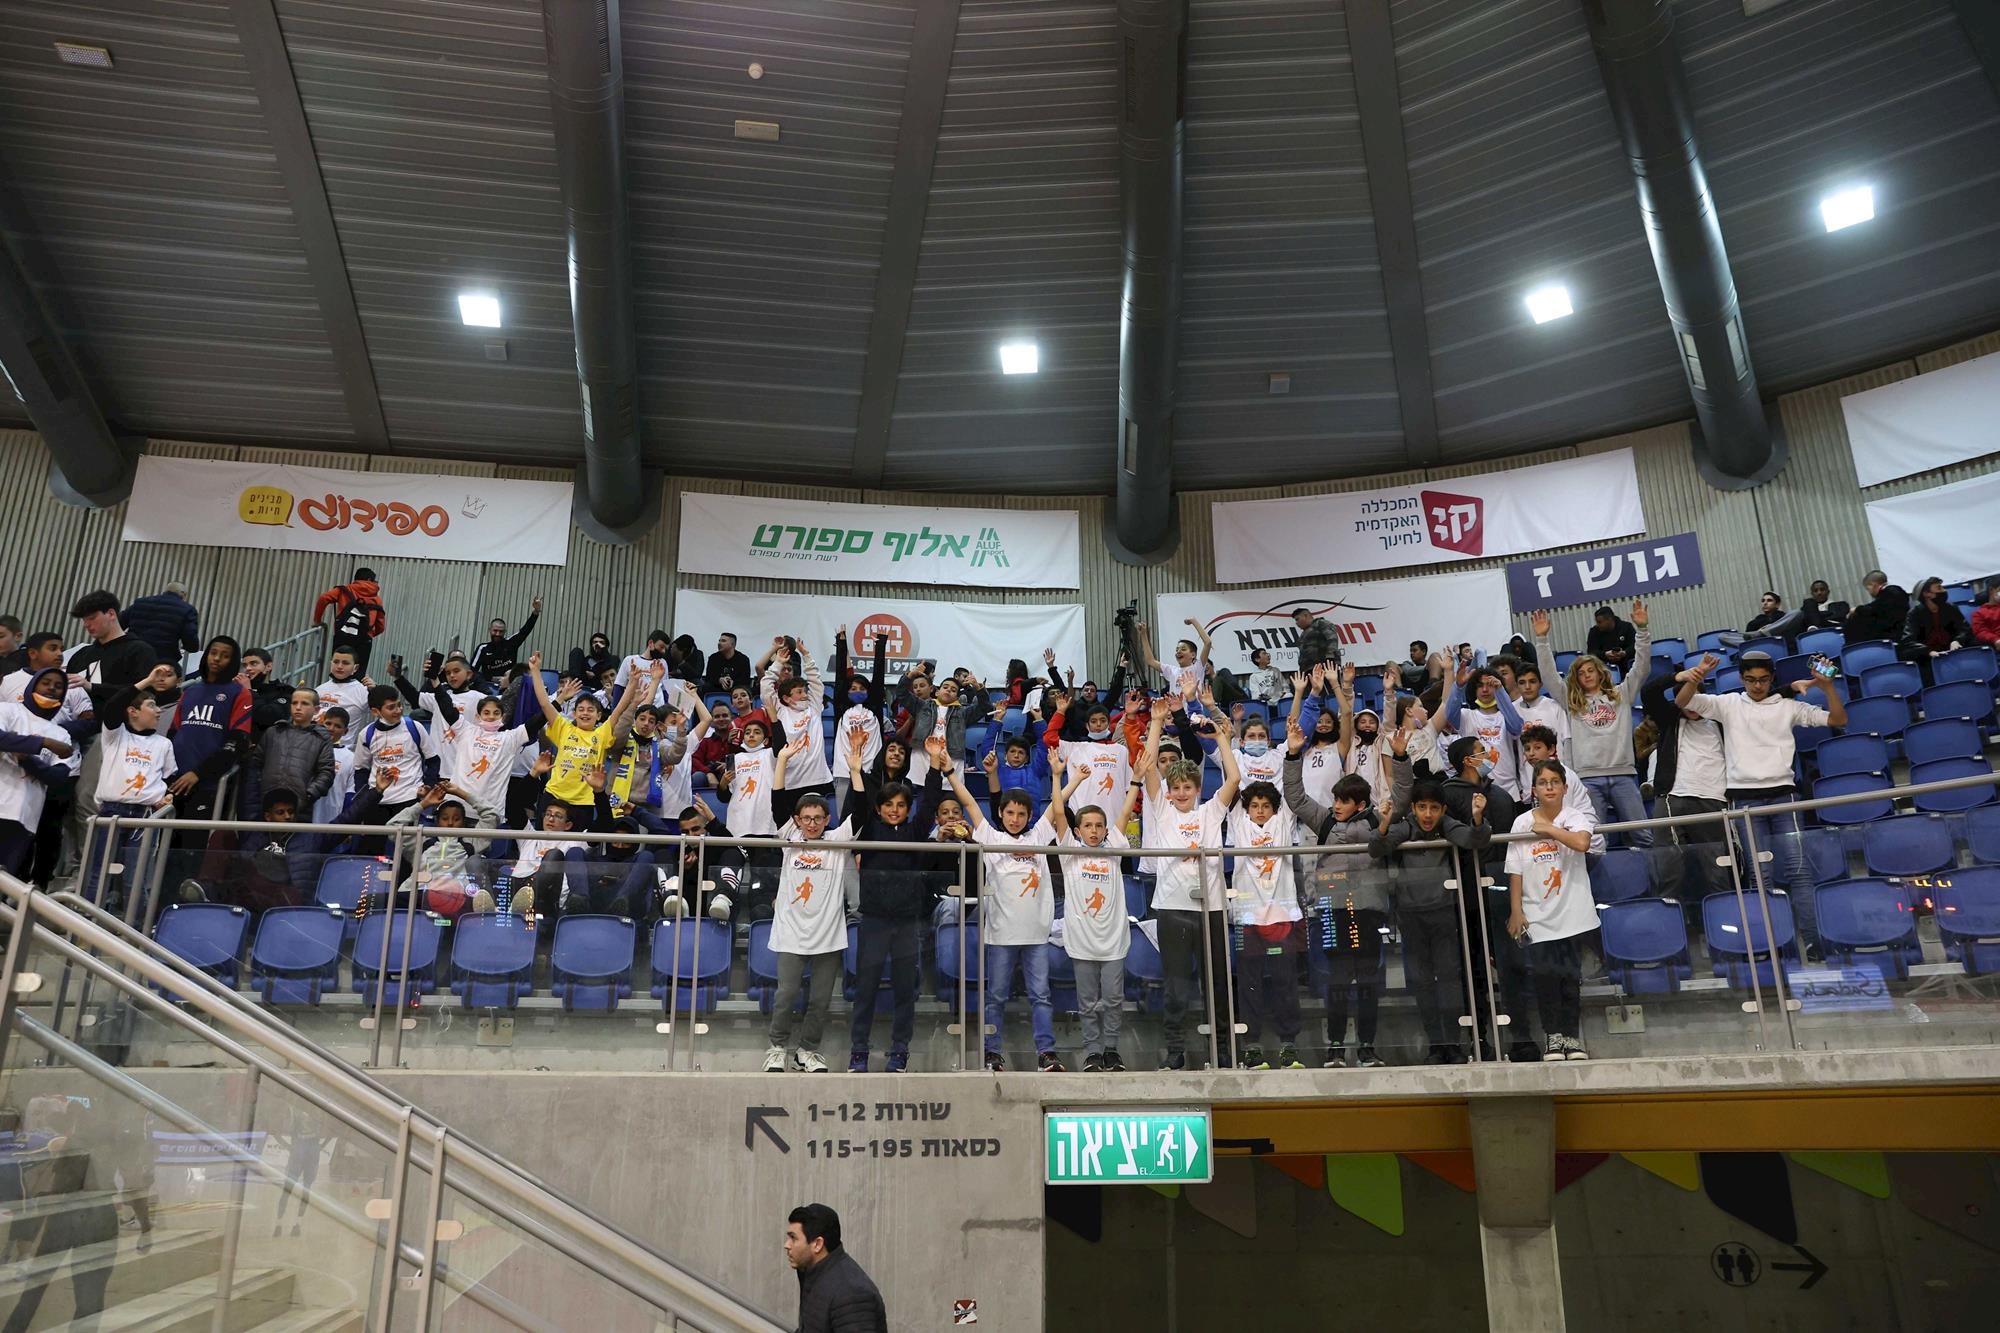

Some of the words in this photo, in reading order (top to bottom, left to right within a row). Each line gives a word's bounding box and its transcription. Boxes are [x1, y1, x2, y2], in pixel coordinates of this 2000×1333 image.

[250, 494, 282, 504] מבינים
[1361, 497, 1418, 515] המכללה
[1355, 514, 1420, 533] האקדמית
[751, 524, 874, 554] ספורט
[882, 526, 971, 562] אלוף
[976, 541, 1001, 549] ALUF
[1379, 530, 1422, 550] לחינוך
[749, 549, 780, 558] ספורט
[783, 551, 812, 561] חנויות
[815, 553, 838, 562] רשת
[1575, 545, 1681, 592] גוש
[1533, 566, 1554, 598] ז
[1233, 627, 1301, 650] עזרא
[1312, 755, 1324, 768] 26
[808, 1103, 866, 1122] 1-12
[875, 1101, 951, 1121] שורות
[807, 1139, 912, 1158] 115-195
[921, 1138, 1001, 1157] כסאות
[1056, 1120, 1149, 1176] יציאה
[1139, 1167, 1149, 1176] EL
